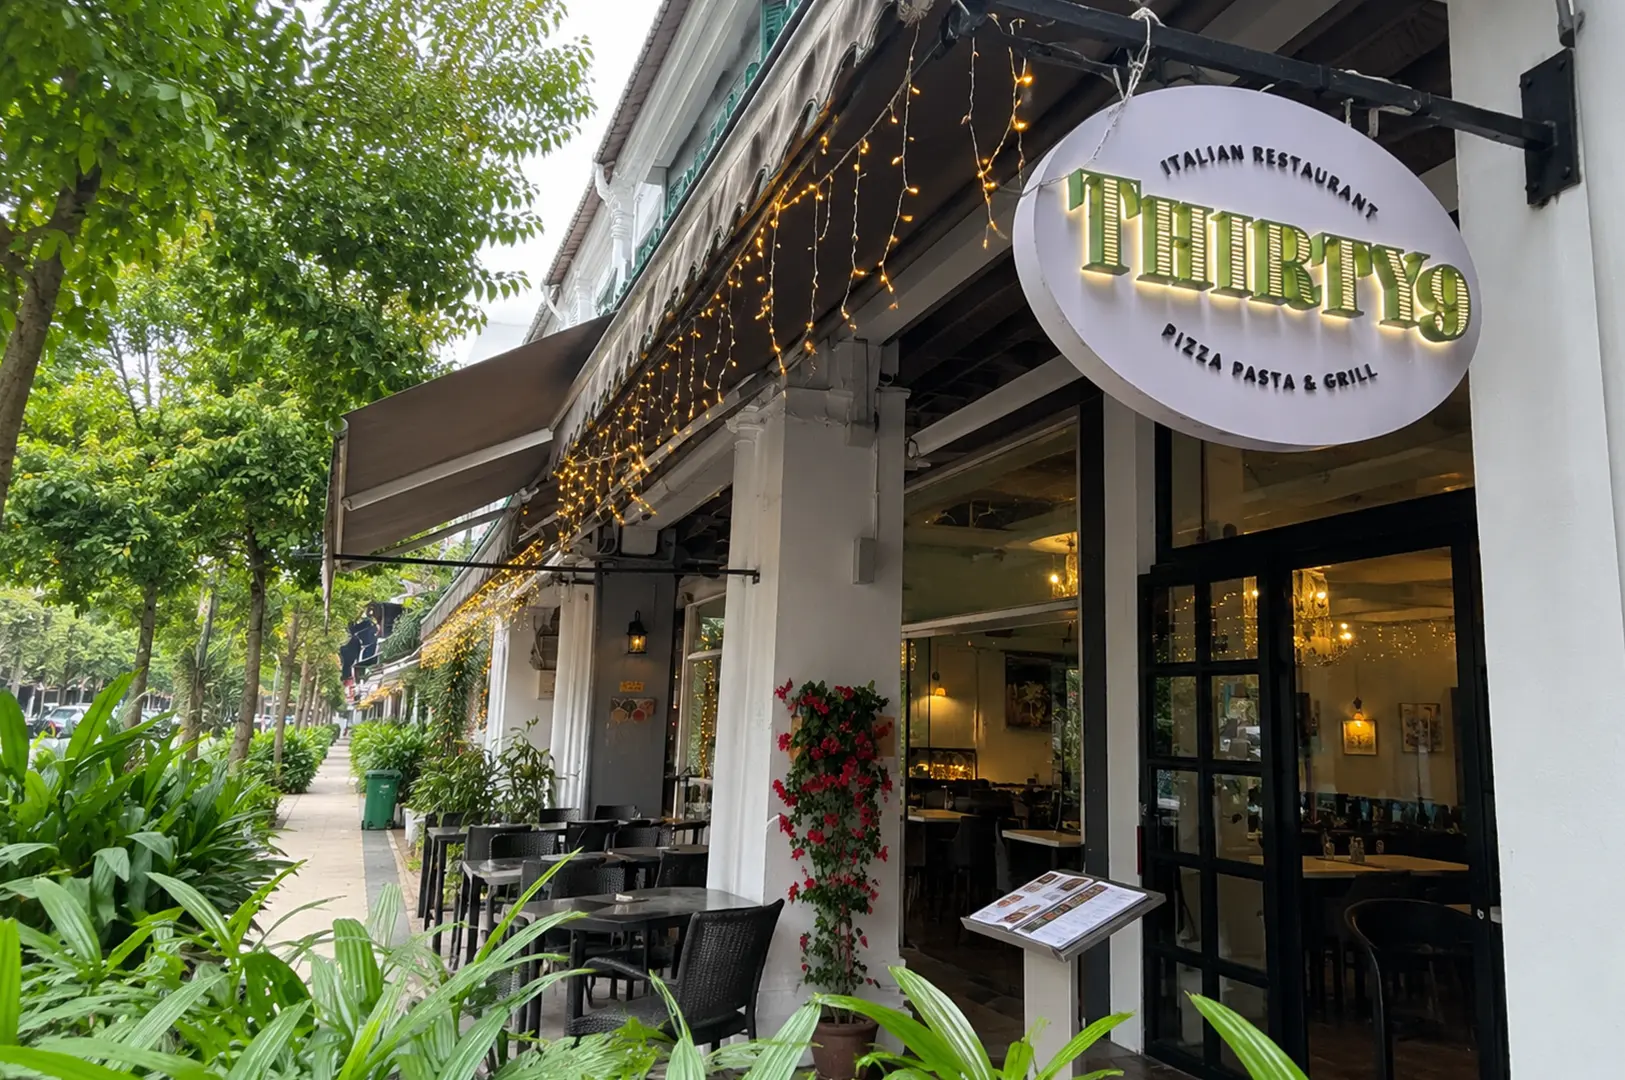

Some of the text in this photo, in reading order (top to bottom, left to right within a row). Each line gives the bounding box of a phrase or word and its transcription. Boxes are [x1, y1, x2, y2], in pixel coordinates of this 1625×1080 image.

[1160, 144, 1379, 219] ITALIAN RESTAURANT
[1068, 168, 1471, 342] THIRTY9
[1161, 322, 1378, 391] PIZZA PASTA & GRILL
